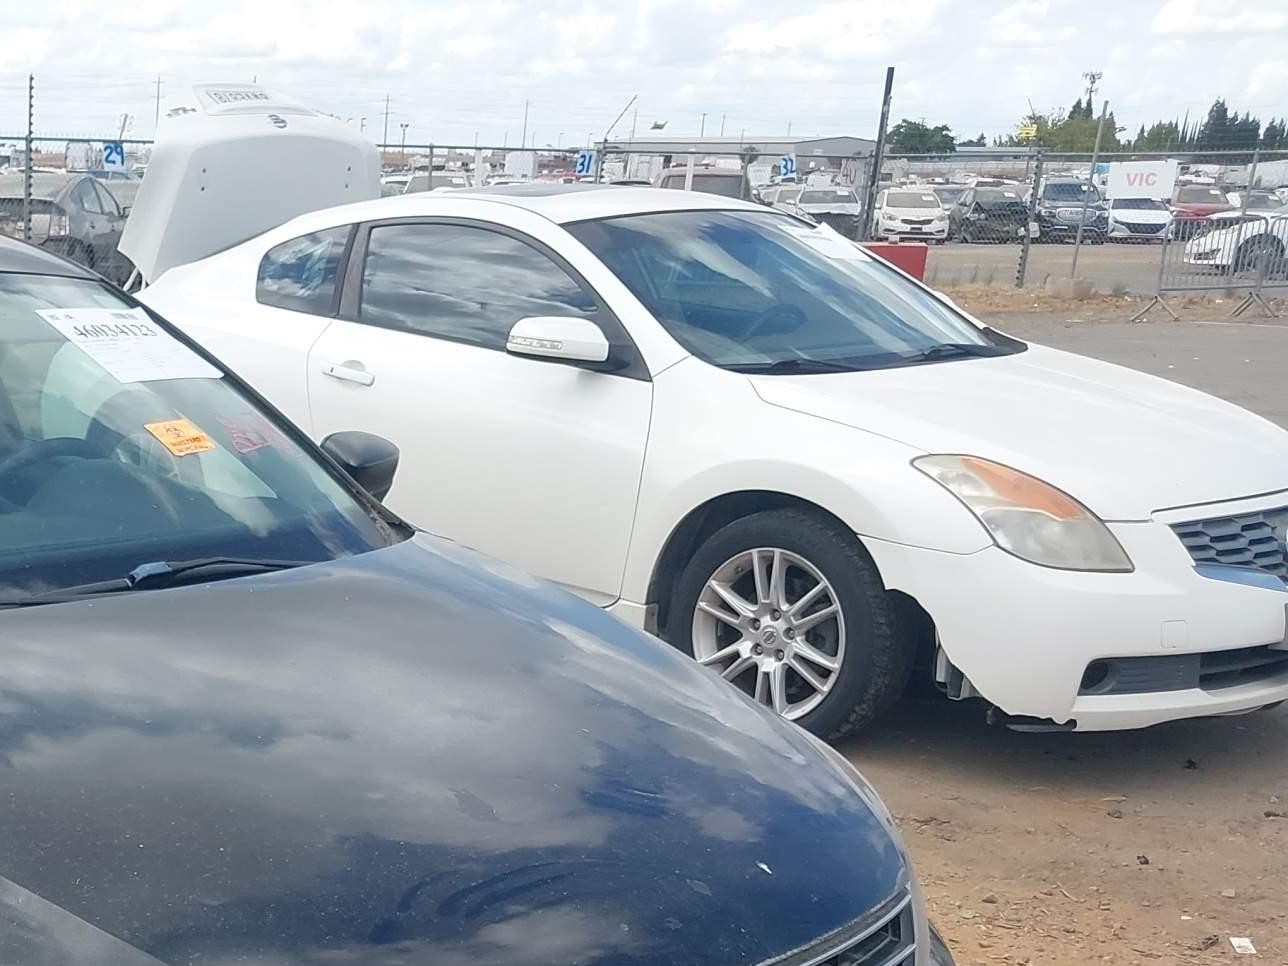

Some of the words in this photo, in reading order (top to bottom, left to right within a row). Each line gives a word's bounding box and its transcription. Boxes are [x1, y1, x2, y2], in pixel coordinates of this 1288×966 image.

[103, 143, 125, 167] 29
[577, 153, 593, 174] 31
[781, 156, 797, 176] 32
[1126, 172, 1158, 187] VIC
[73, 323, 158, 339] 46034123
